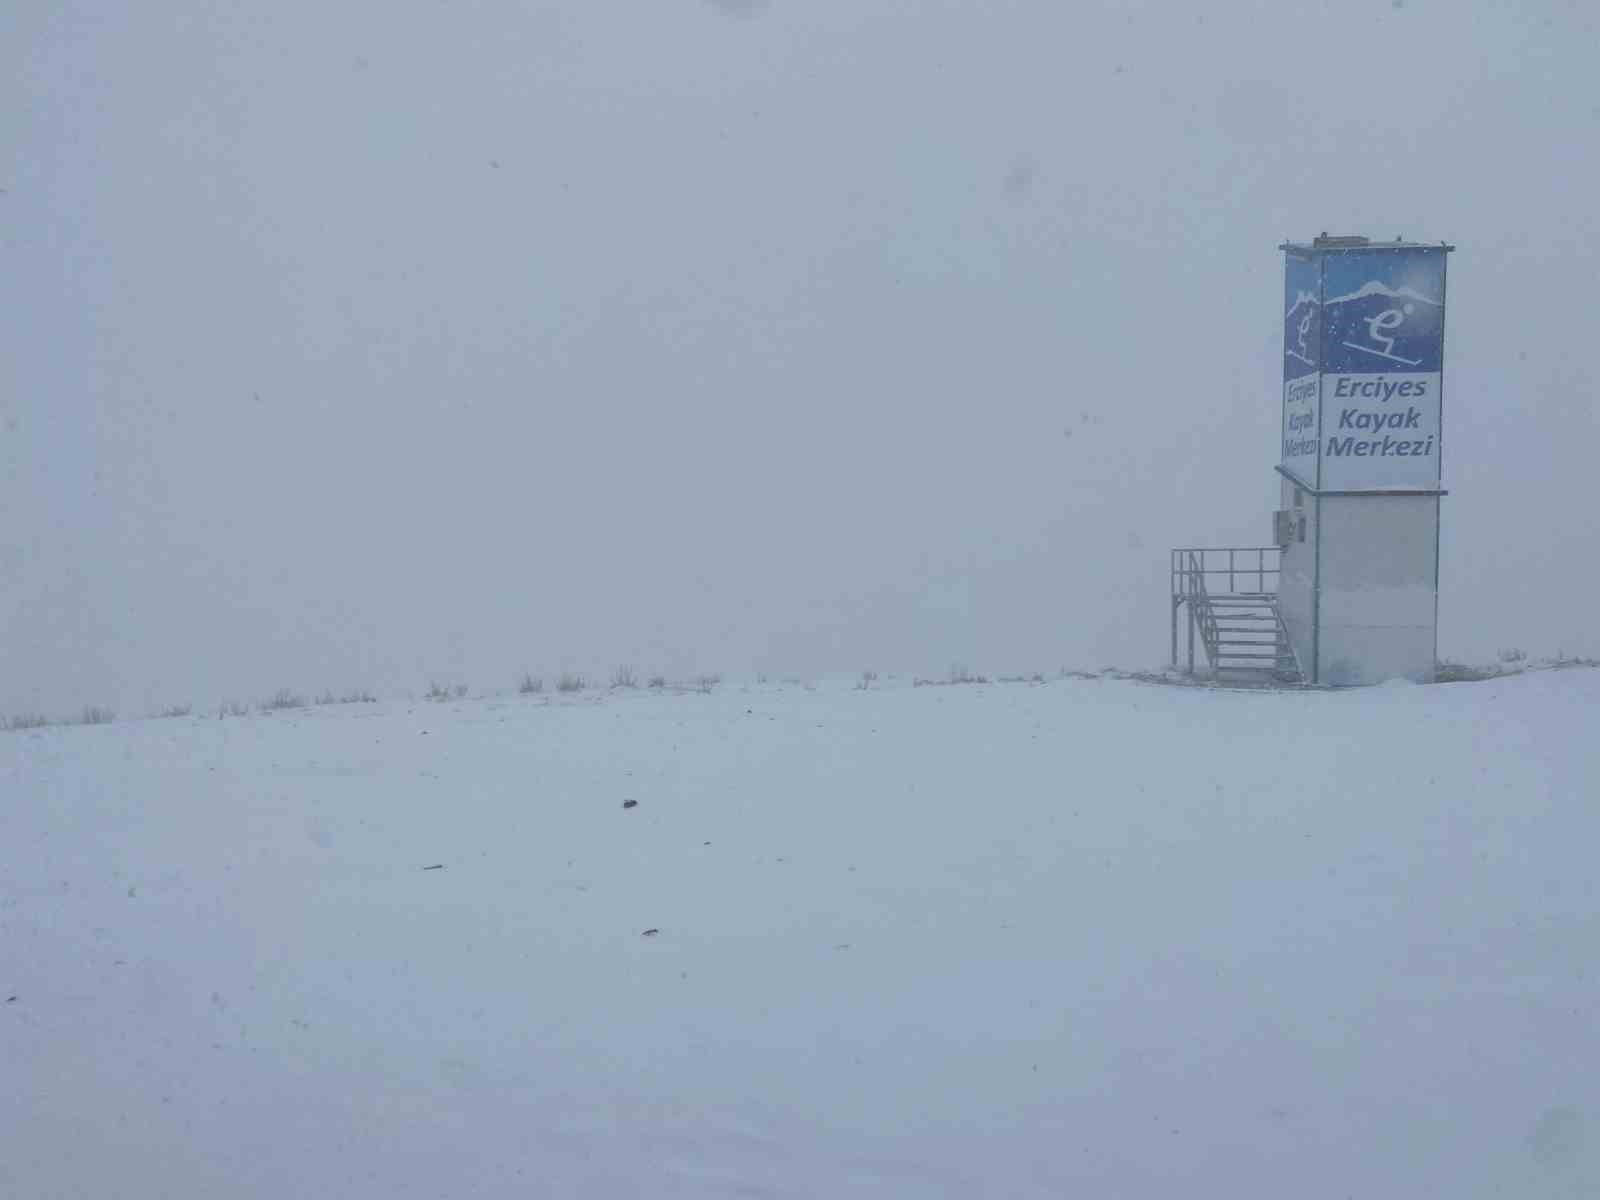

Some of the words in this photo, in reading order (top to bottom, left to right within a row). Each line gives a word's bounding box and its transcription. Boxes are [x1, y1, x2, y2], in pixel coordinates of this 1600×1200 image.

[1335, 377, 1427, 402] Erciyes
[1339, 406, 1421, 433] Kayak
[1326, 435, 1434, 457] Merkezi
